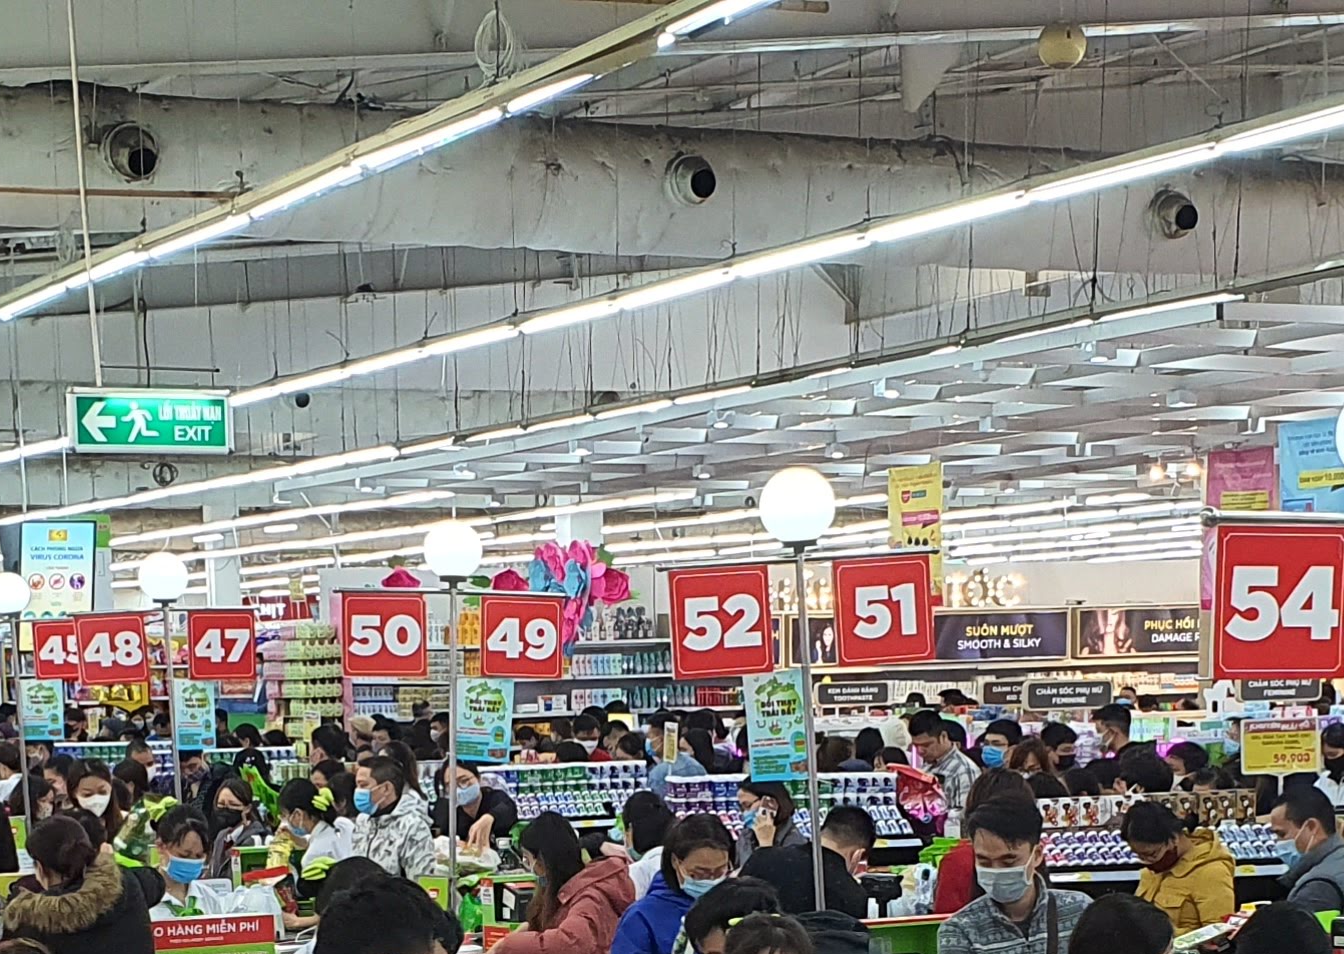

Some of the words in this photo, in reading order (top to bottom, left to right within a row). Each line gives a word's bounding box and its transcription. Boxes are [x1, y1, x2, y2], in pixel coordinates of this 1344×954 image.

[174, 425, 212, 441] EXIT
[259, 602, 287, 618] HỊT
[1224, 565, 1340, 642] 54
[682, 593, 763, 652] 52
[853, 582, 918, 639] 51
[1143, 618, 1174, 632] PHỤC
[348, 614, 421, 657] 50
[486, 616, 558, 661] 49
[965, 622, 999, 637] SUÔN
[957, 638, 1001, 650] SMOOTH
[1003, 639, 1011, 649] &
[1012, 638, 1041, 648] SILKY
[1151, 632, 1193, 644] DAMAGE
[83, 630, 144, 668] 48
[194, 628, 250, 664] 47
[1059, 685, 1074, 695] SÓC
[167, 923, 203, 937] HÀNG
[206, 919, 236, 934] MIỄN
[239, 919, 259, 932] PHÍ
